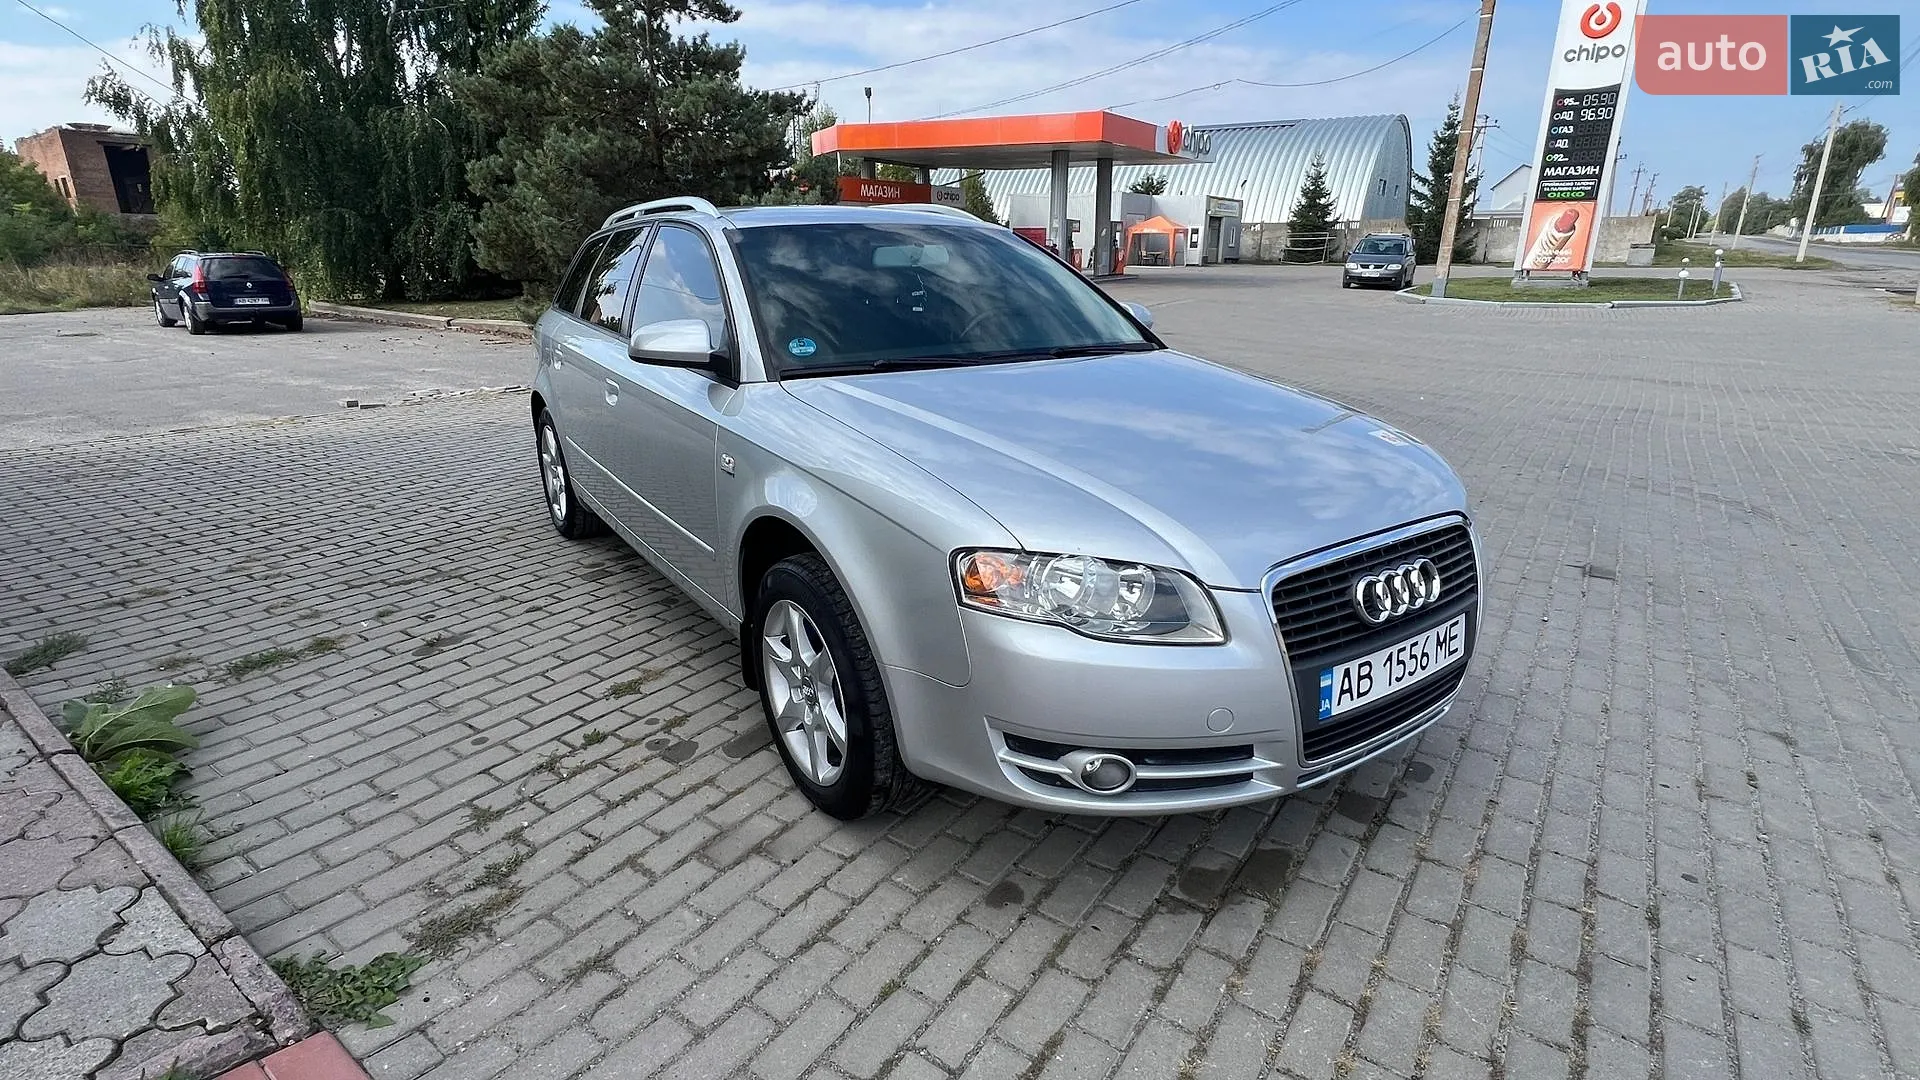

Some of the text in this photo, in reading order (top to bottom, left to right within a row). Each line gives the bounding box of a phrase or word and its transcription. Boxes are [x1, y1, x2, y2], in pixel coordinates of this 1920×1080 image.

[1564, 43, 1626, 63] chipo
[1582, 92, 1617, 107] 85.90
[1580, 107, 1614, 121] 96.90
[1558, 125, 1574, 134] ГАЗ
[1183, 124, 1212, 159] chipo
[1543, 165, 1600, 177] МАГАЗИН
[860, 183, 901, 199] МАГАЗИН
[1337, 620, 1460, 706] AB 1556 ME
